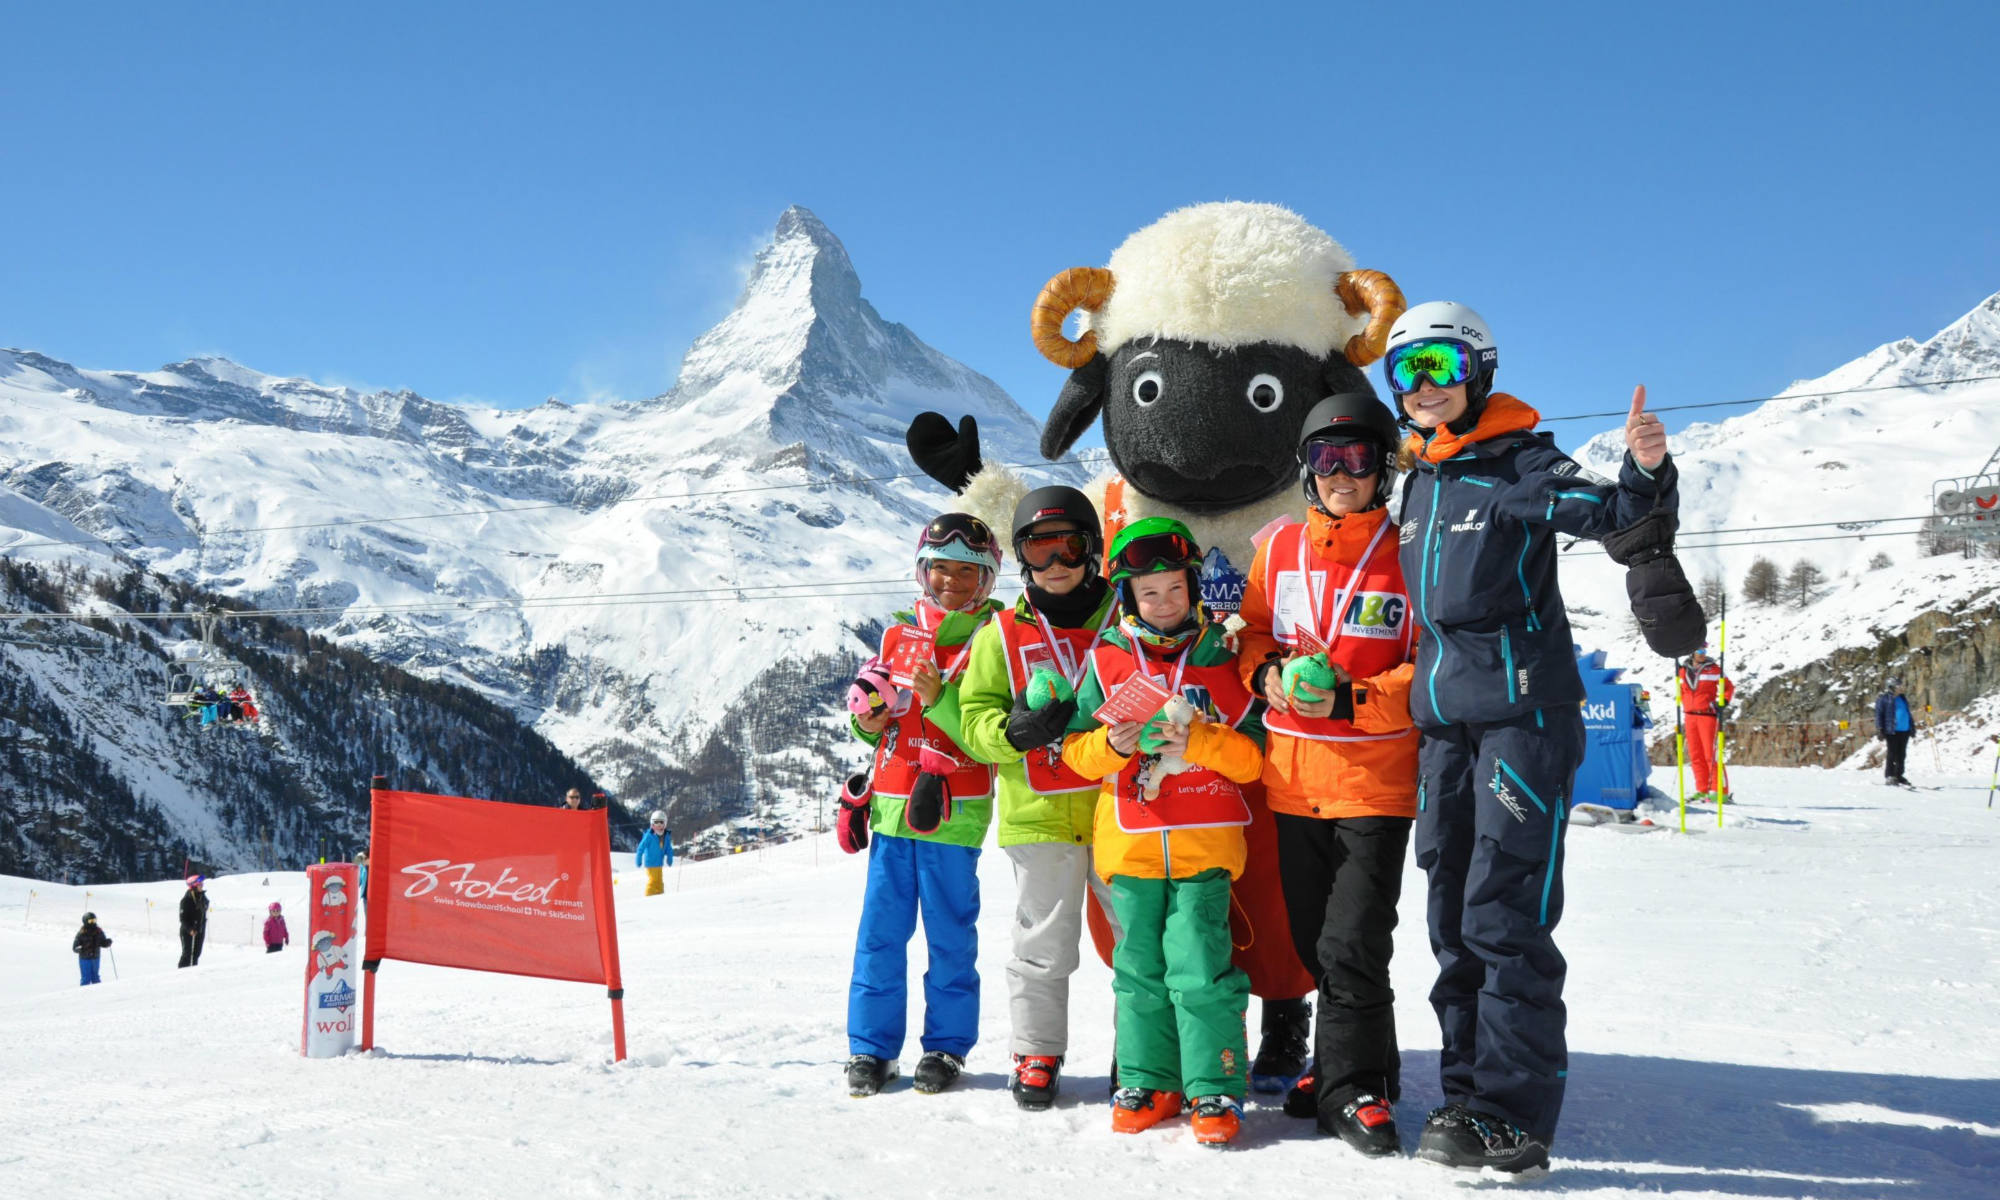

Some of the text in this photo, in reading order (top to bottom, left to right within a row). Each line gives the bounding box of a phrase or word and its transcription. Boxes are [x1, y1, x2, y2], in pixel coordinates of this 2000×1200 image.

[1200, 577, 1247, 600] RMA
[433, 895, 585, 922] Swiss SnowboardSchool The SkiSchool
[554, 899, 584, 908] zermatt
